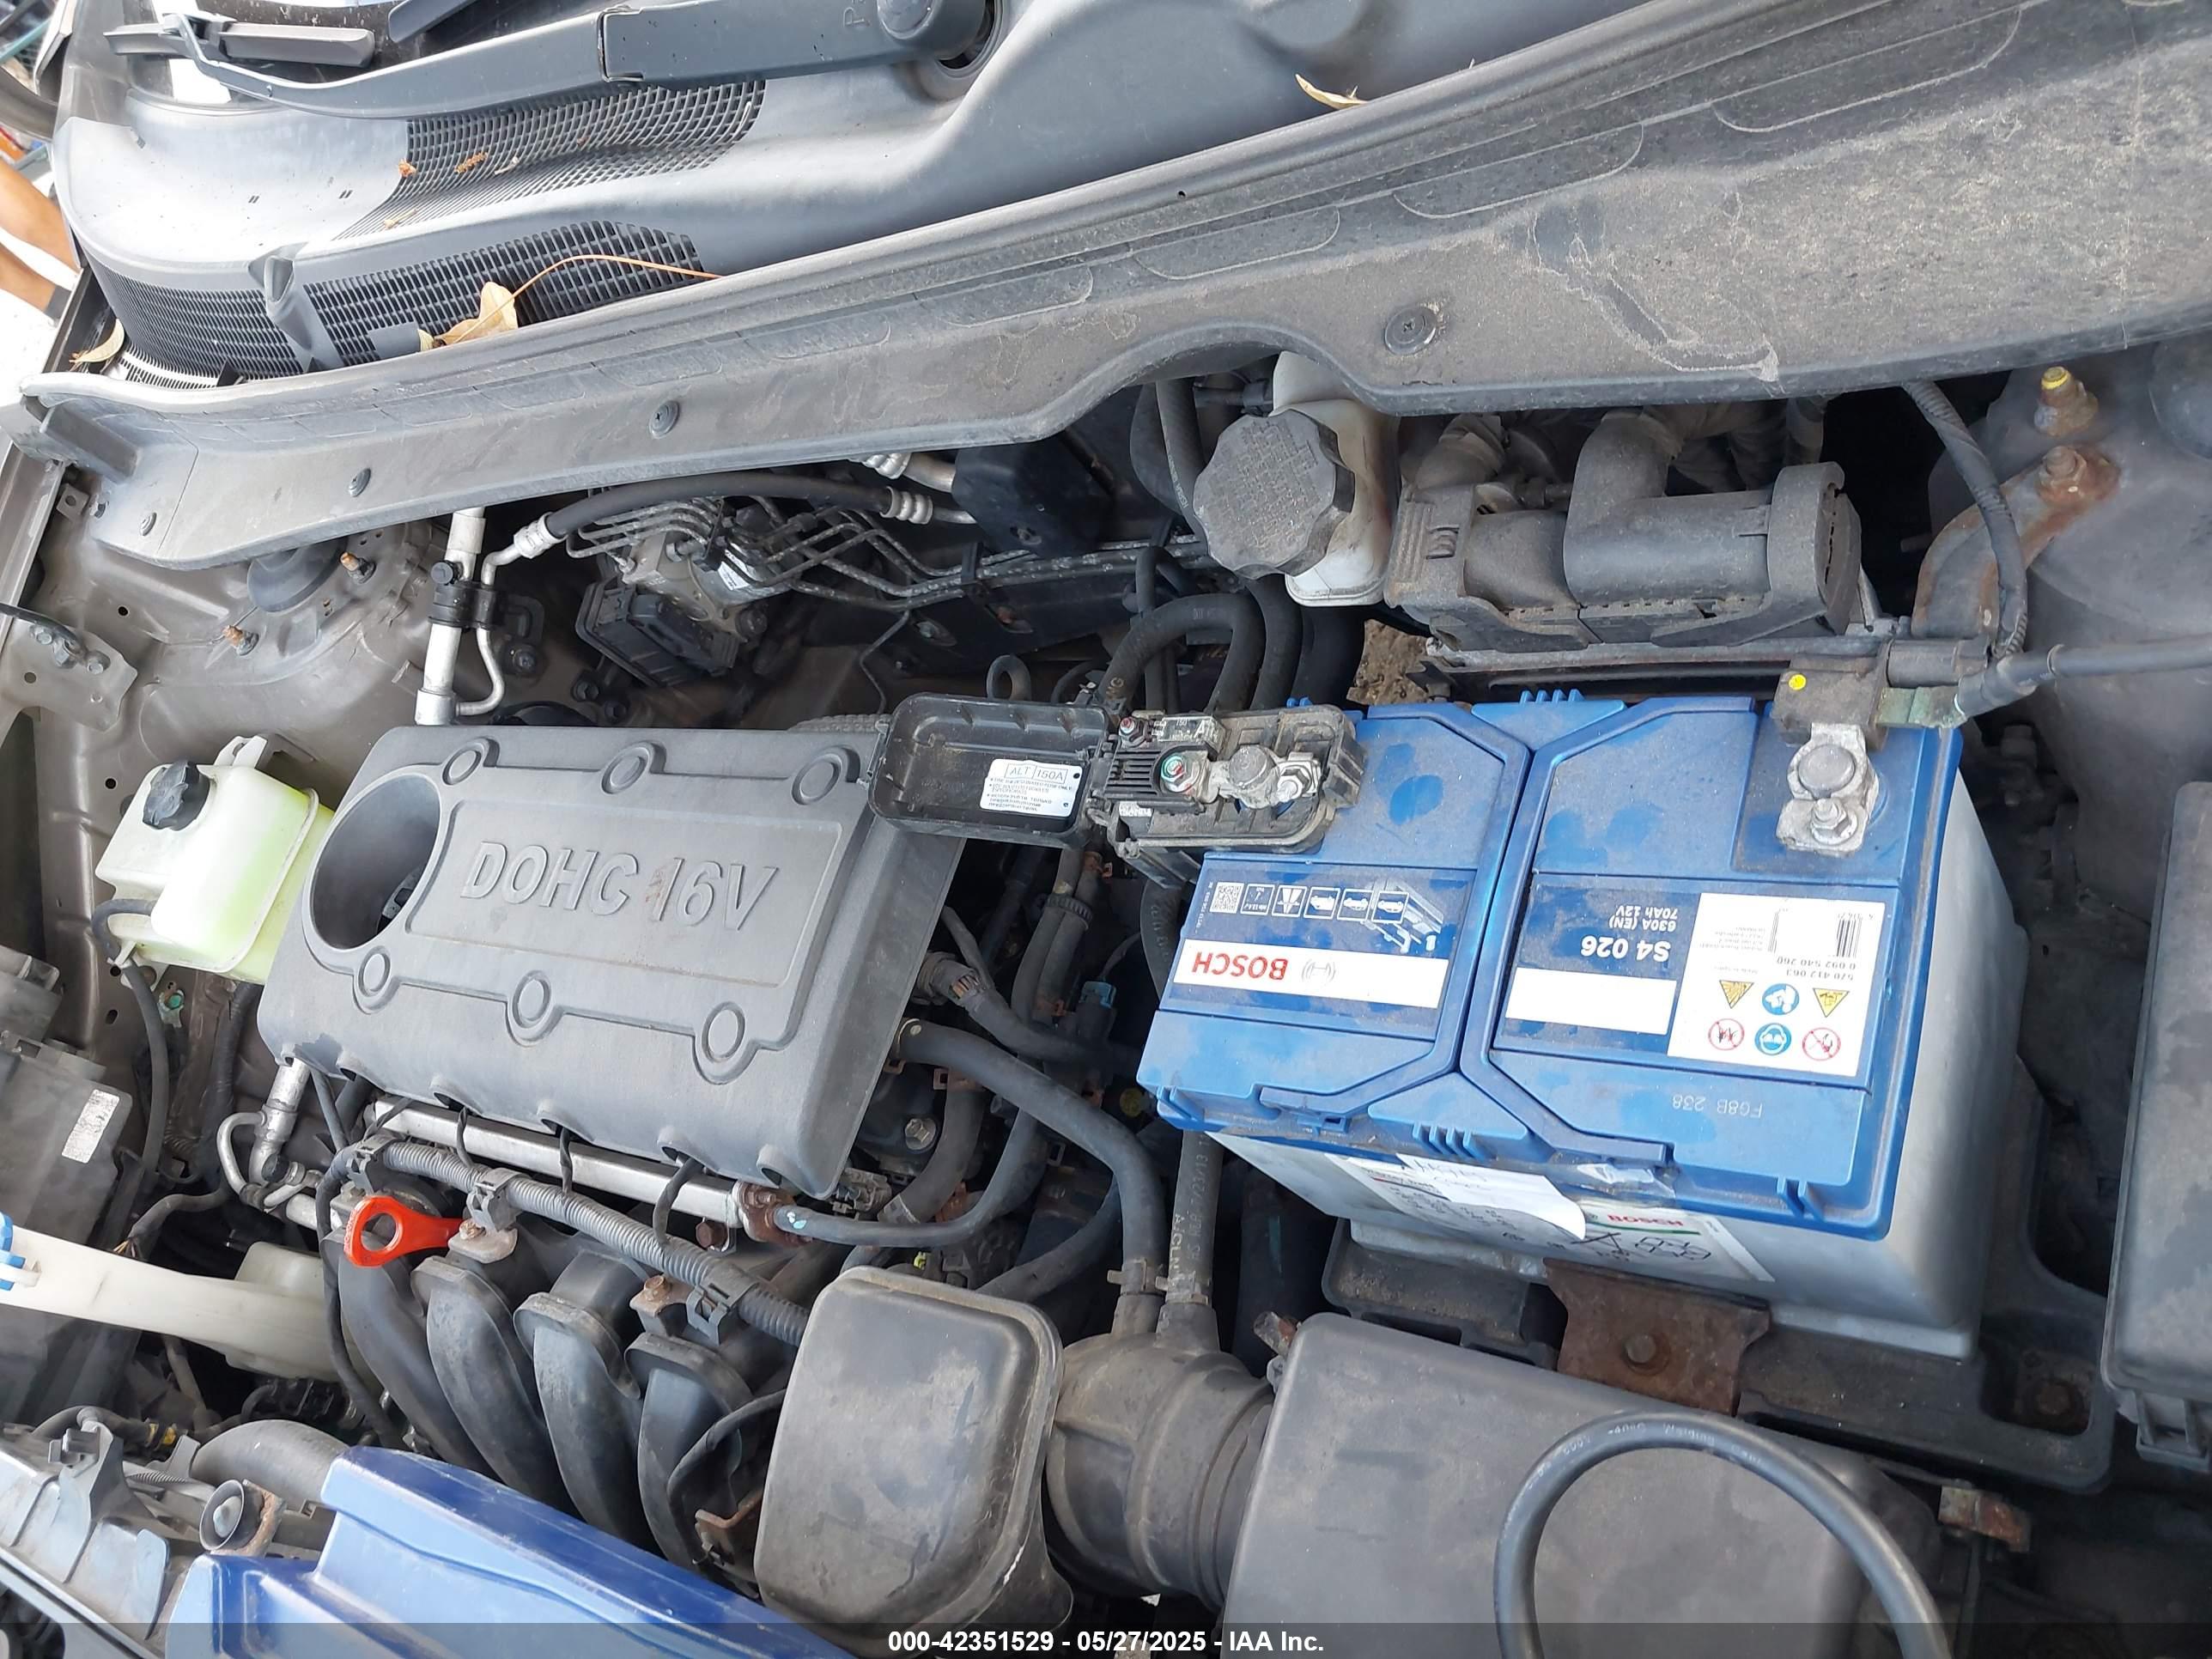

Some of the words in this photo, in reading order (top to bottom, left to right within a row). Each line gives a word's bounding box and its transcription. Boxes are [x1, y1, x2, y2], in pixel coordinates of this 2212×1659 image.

[1010, 767, 1032, 776] ALT
[1036, 769, 1064, 781] 150A
[460, 841, 639, 916] DOHC
[650, 857, 780, 932] 16V
[1614, 904, 1641, 917] 12V
[1644, 905, 1678, 919] 70Ah
[1607, 915, 1638, 929] (EN)
[1641, 918, 1676, 932] 630A
[1579, 934, 1628, 959] 026
[1634, 939, 1671, 963] S4
[1192, 951, 1289, 981] BOSCH
[1775, 955, 1796, 965] 260
[1799, 957, 1820, 967] 540
[1824, 960, 1846, 969] 092
[1847, 961, 1856, 969] 0
[1784, 968, 1806, 977] 063
[1808, 969, 1830, 979] 412
[1832, 971, 1853, 981] 570
[1671, 1093, 1705, 1111] 238
[1607, 1213, 1684, 1227] BOSCH
